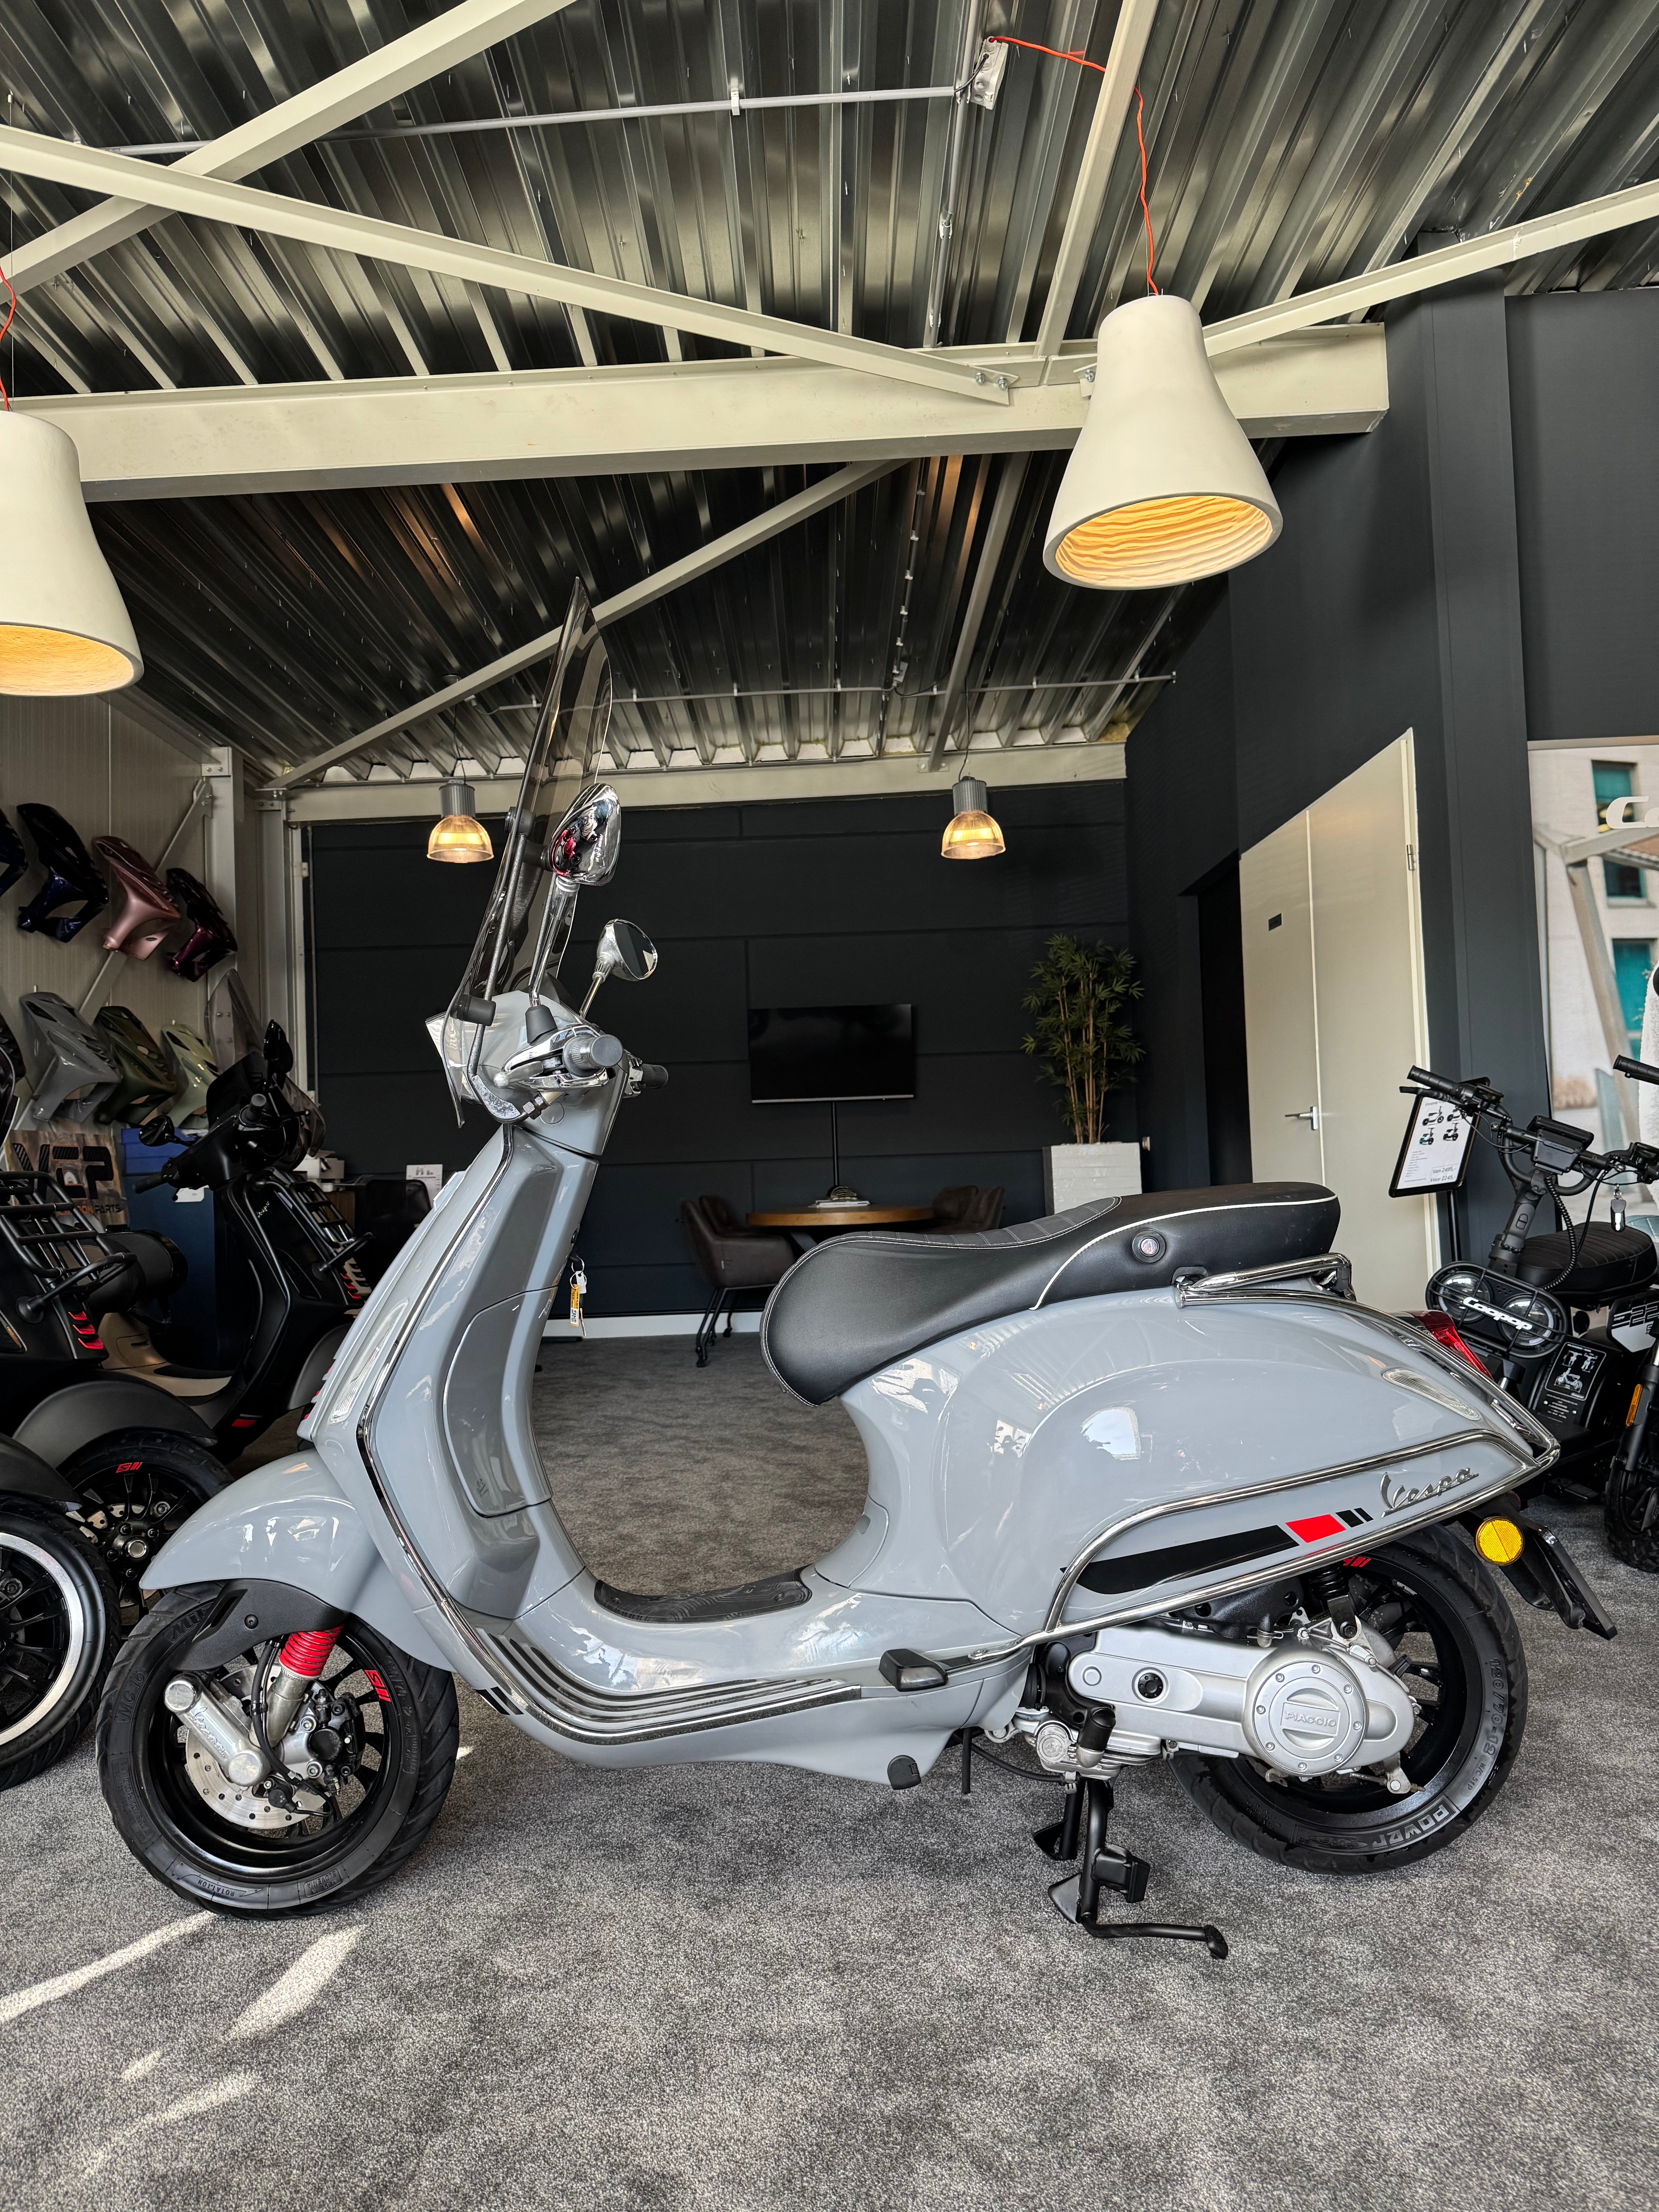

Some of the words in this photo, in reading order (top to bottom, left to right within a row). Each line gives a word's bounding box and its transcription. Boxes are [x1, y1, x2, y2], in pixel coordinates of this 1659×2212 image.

[95, 1204, 121, 1214] PARTS
[1463, 1297, 1532, 1330] Coopop
[1380, 1467, 1479, 1518] Vespa
[1483, 1657, 1505, 1755] 120/70-12
[1285, 1711, 1337, 1727] PIAGGIO
[198, 1879, 235, 1896] ROTATION
[307, 1871, 337, 1889] SLOVENIA
